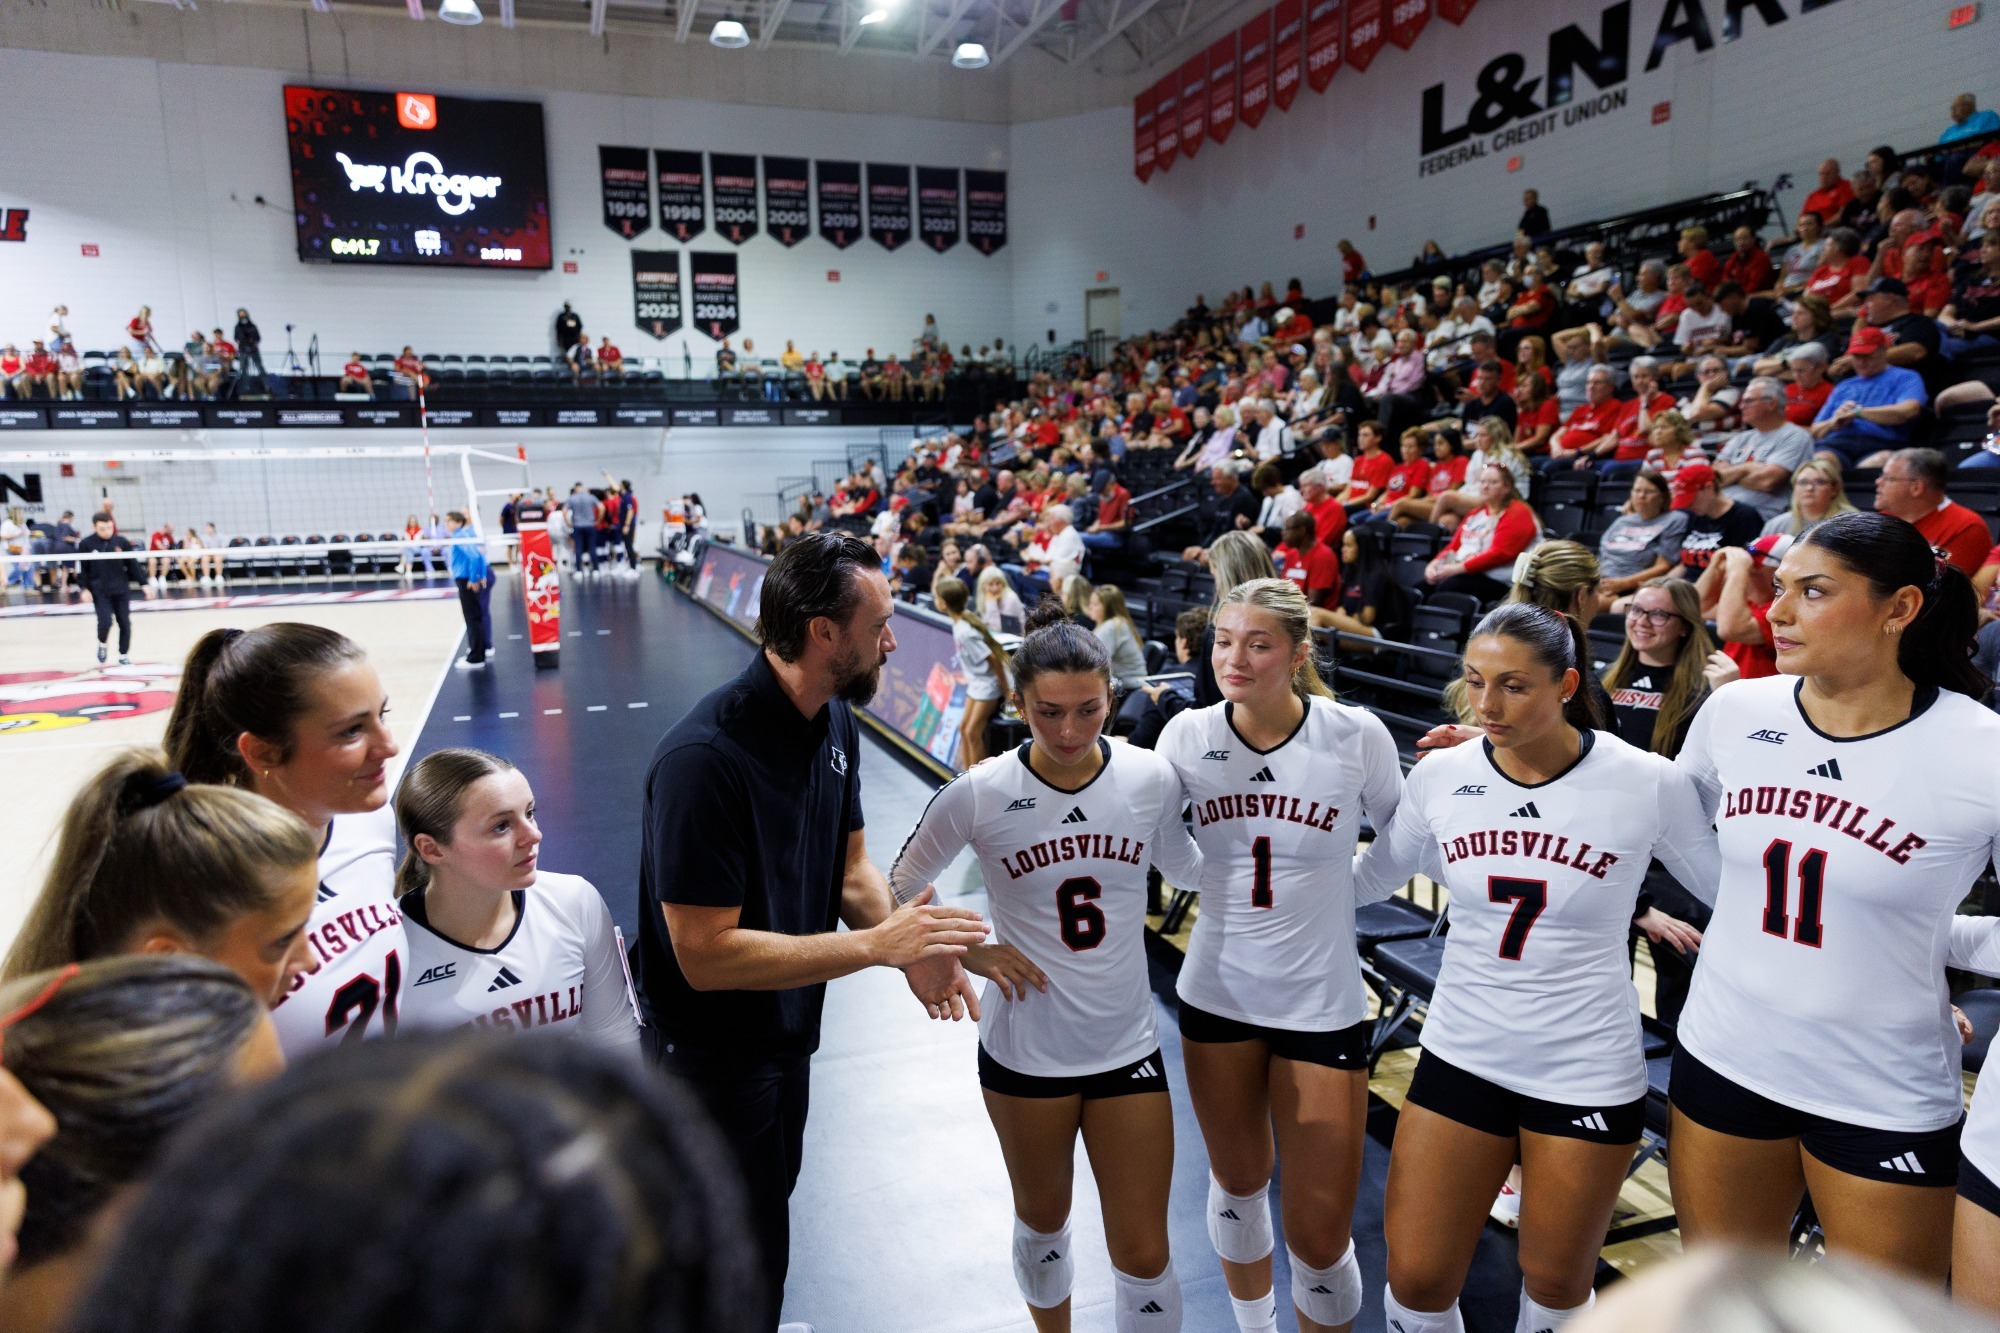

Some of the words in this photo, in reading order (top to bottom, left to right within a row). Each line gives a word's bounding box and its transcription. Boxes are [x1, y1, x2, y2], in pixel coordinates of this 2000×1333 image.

[1421, 0, 1632, 156] L&N
[1419, 140, 1488, 178] FEDERAL
[1492, 113, 1556, 152] CREDIT
[1563, 88, 1629, 127] UNION
[391, 151, 501, 215] Kroger
[607, 201, 647, 218] 1996
[715, 207, 757, 223] 2004
[638, 303, 680, 318] 2023
[696, 304, 738, 320] 2024
[1201, 751, 1231, 761] ACC
[1747, 729, 1789, 744] ACC
[1004, 798, 1037, 812] ACC
[1452, 785, 1488, 795] ACC
[1198, 793, 1339, 832] LOUISVILLE
[1725, 787, 1927, 865] LOUISVILLE
[1001, 834, 1144, 879] LOUISVILLE
[1251, 836, 1273, 908] 1
[1442, 830, 1619, 879] LOUISVILLE
[1055, 875, 1106, 951] 6
[1762, 838, 1828, 949] 11
[1488, 875, 1547, 961] 7
[413, 962, 457, 987] ACC
